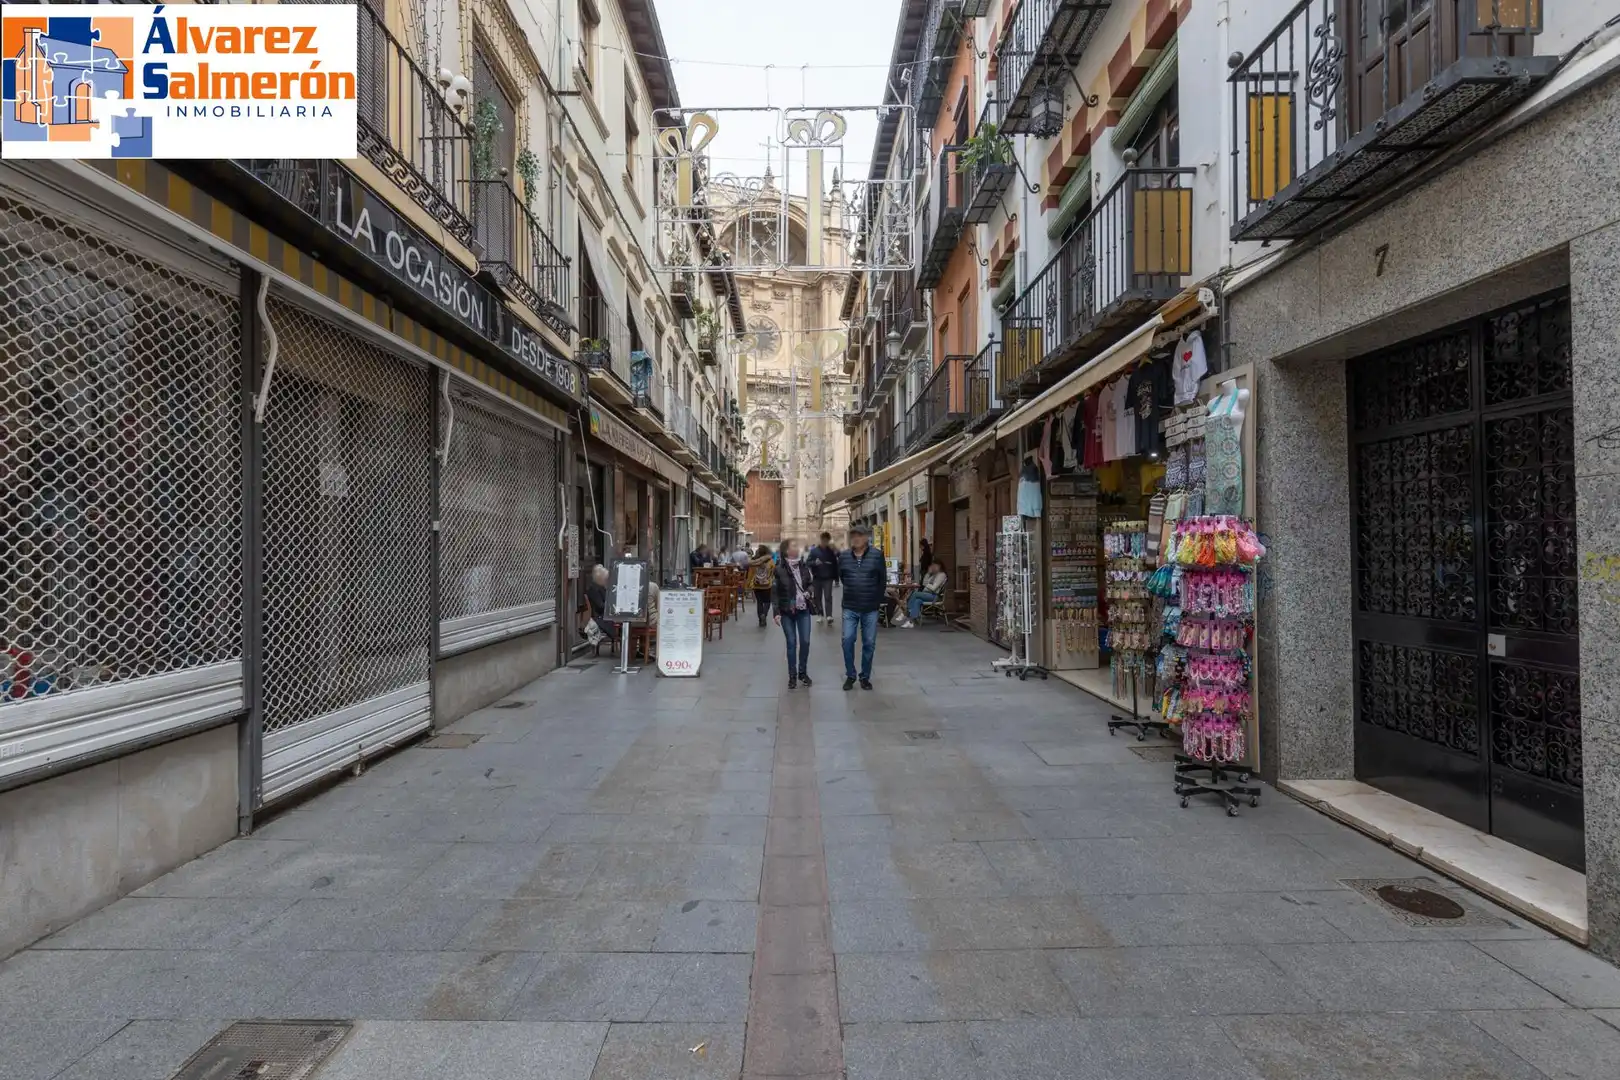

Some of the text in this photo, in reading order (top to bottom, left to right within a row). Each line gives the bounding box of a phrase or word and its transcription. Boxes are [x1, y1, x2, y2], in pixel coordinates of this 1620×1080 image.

[336, 187, 484, 330] LA OCASIÓN
[1374, 243, 1389, 277] 7
[511, 326, 576, 394] DESDE 1908
